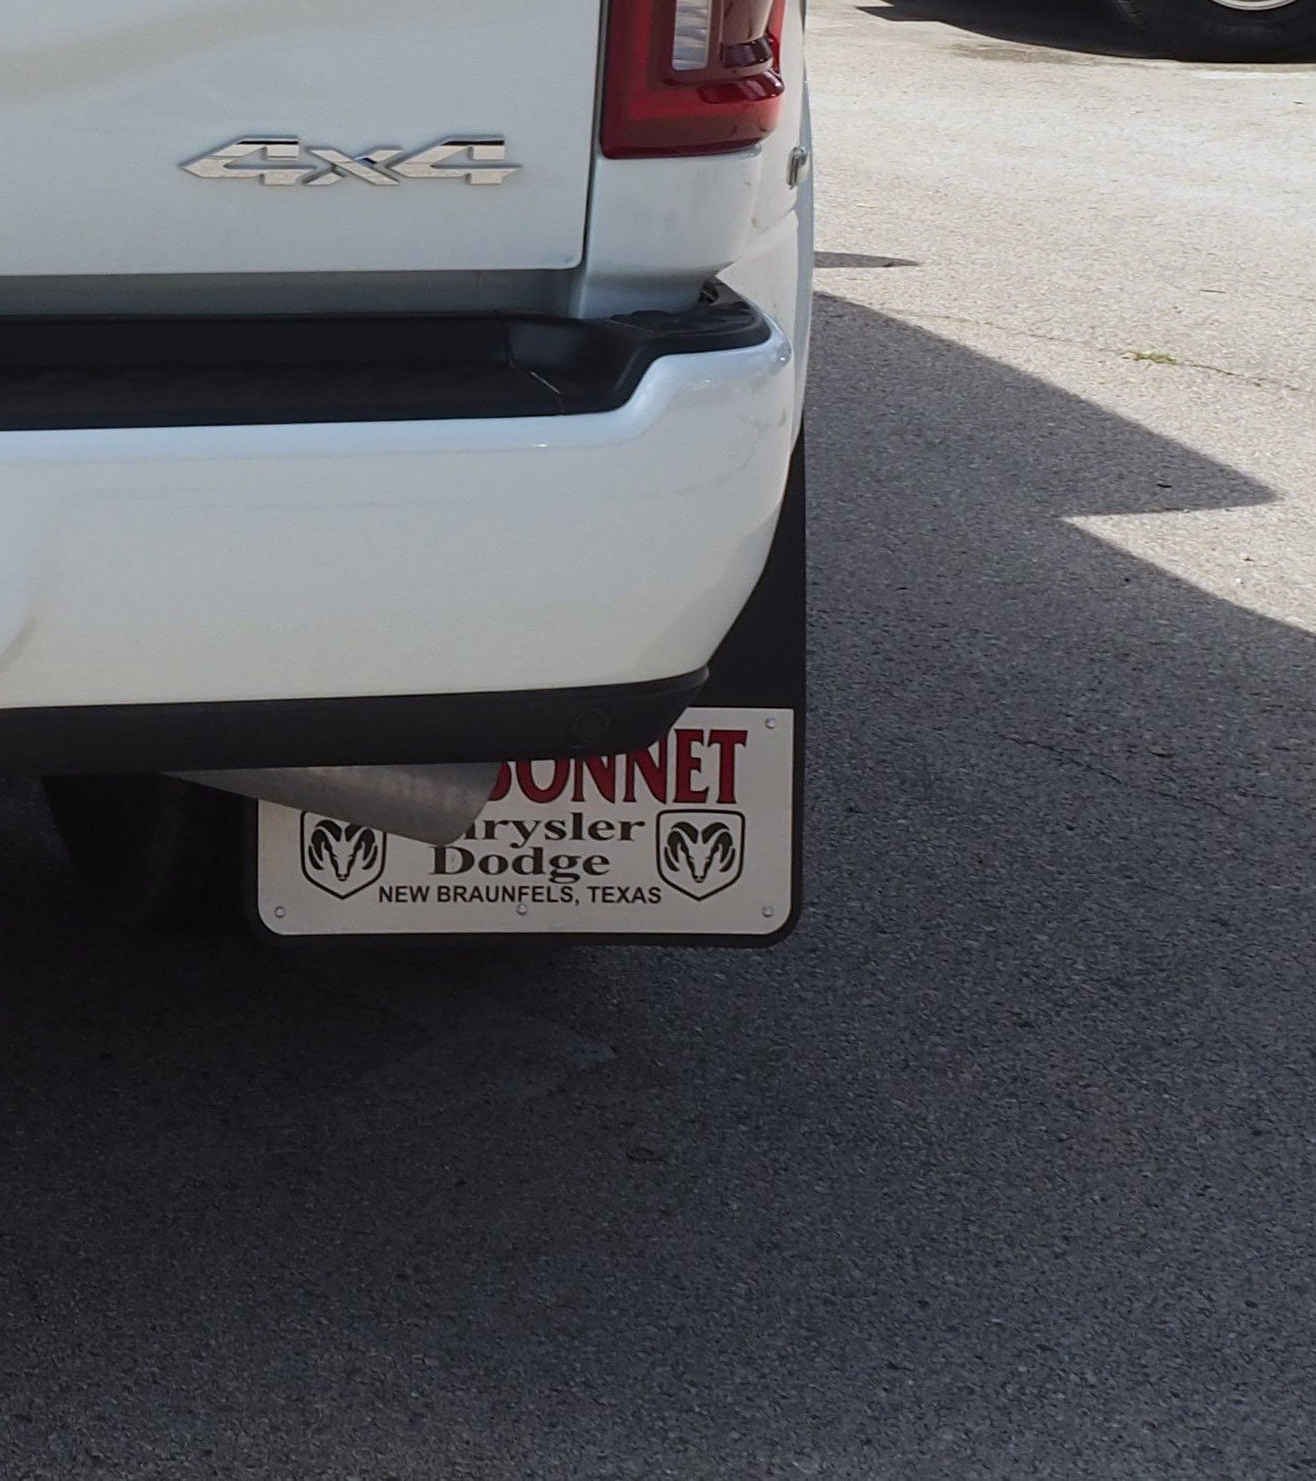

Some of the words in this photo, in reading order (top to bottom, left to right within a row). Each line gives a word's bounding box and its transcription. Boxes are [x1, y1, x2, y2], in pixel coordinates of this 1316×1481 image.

[487, 728, 748, 805] ONNET
[463, 811, 646, 849] rysler
[428, 846, 611, 883] Dodge
[378, 886, 430, 904] NEW
[436, 885, 580, 906] BRAUNFELS,
[587, 886, 662, 904] TEXAS
